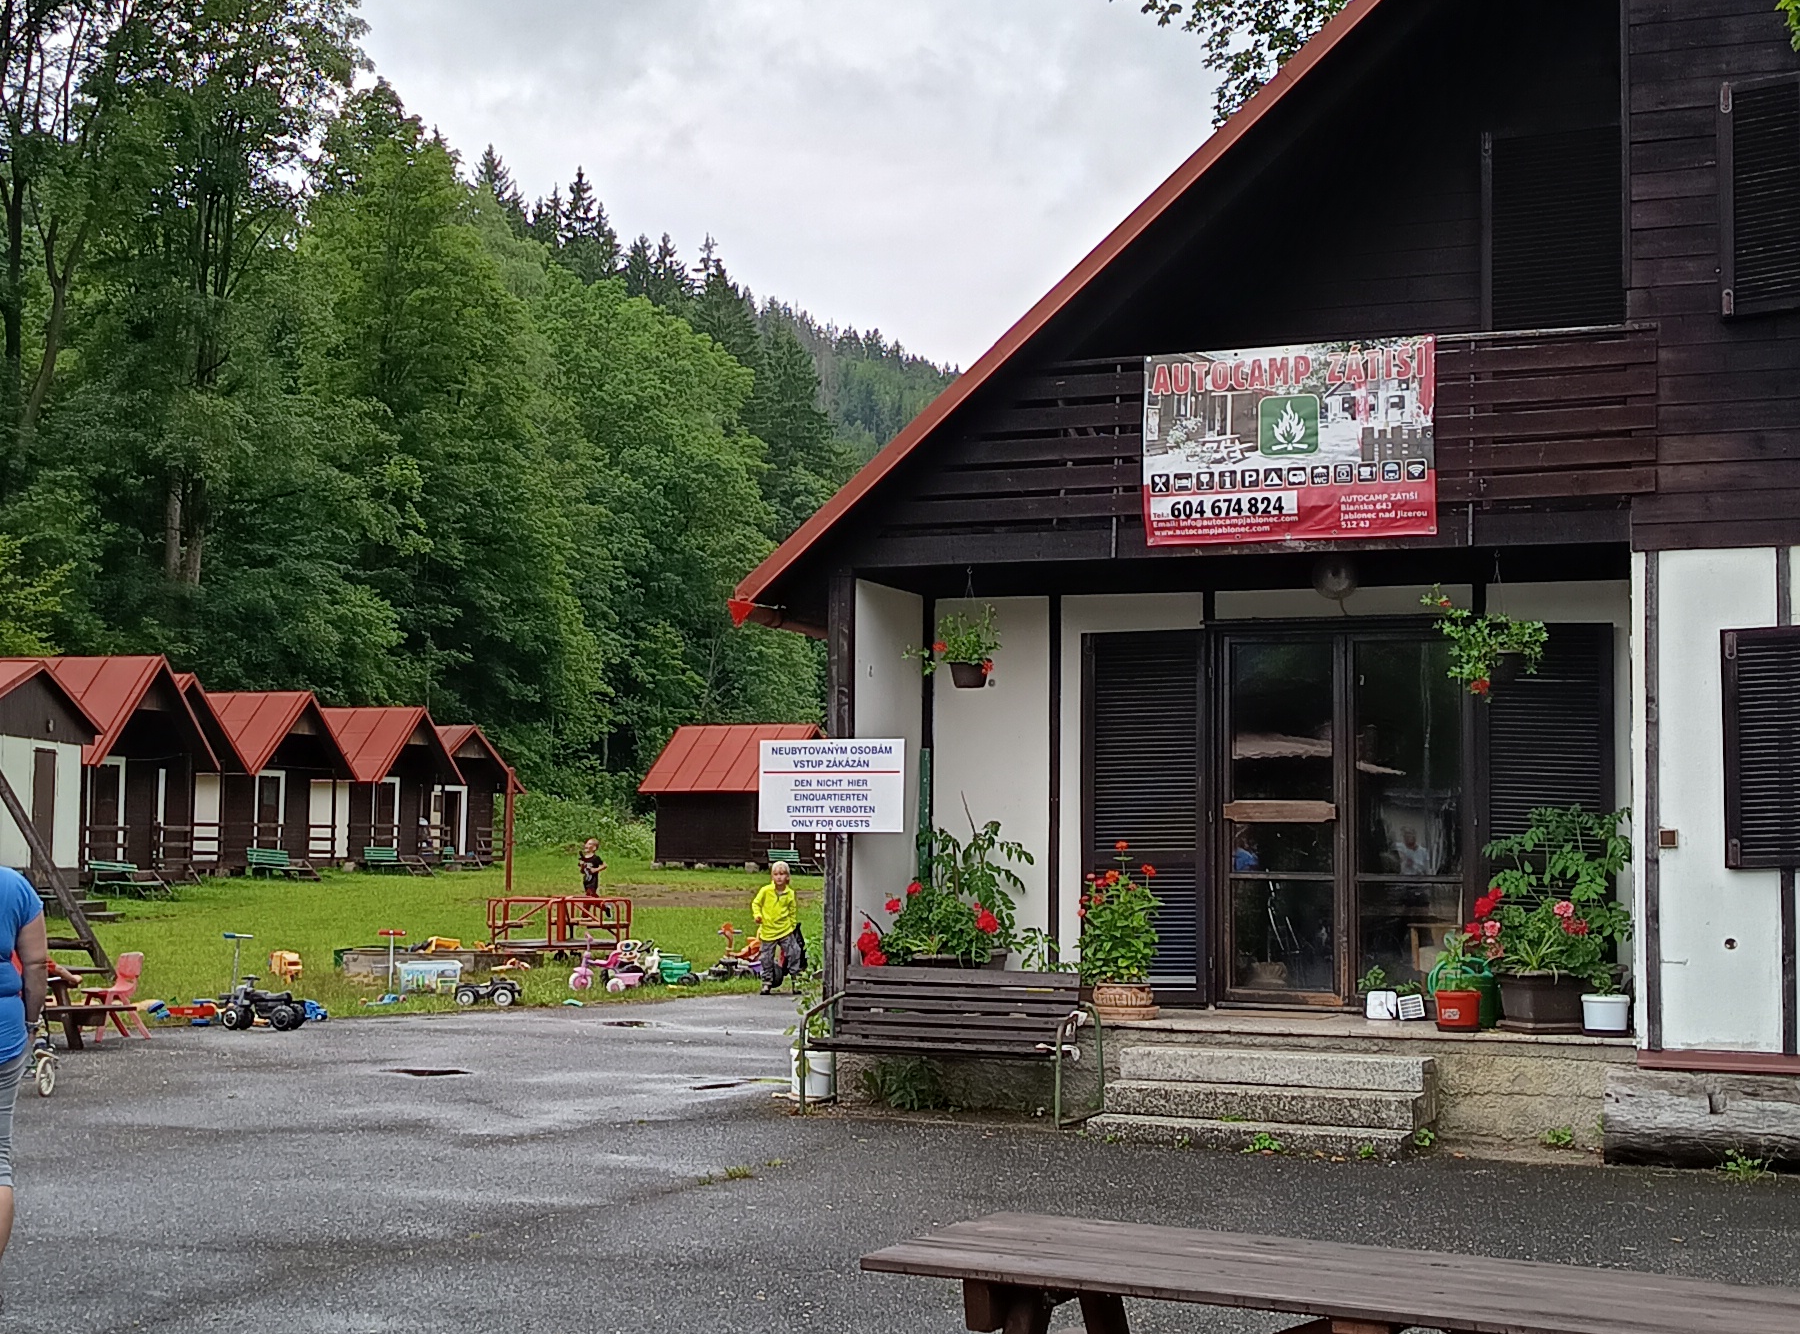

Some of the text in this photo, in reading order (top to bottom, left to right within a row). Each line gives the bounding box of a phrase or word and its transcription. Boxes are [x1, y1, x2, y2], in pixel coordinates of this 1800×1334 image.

[1152, 341, 1427, 395] AUTOCAMP ZÁTIŠÍ
[1244, 471, 1257, 487] P
[1340, 493, 1388, 503] AUTOCAMP
[1170, 499, 1206, 518] 604
[1211, 498, 1243, 517] 674
[1247, 496, 1285, 515] 824
[1340, 503, 1374, 511] Blansko
[1340, 510, 1428, 521] Jablonec nad Jizerou
[1153, 516, 1299, 528] Email: info@autocampjablonec.com
[1154, 525, 1270, 536] www.autocampjablonec.com
[771, 743, 893, 755] NEUBYTOVANÝM OSOBÁM
[793, 757, 870, 768] VSTUP ZÁKÁZÁN
[794, 779, 868, 787] DEN NICHT HIER
[794, 793, 868, 801] EINQUARTIERTEN
[786, 805, 876, 814] EINTRITT VERBOTEN
[791, 819, 870, 828] ONLY FOR GUESTS
